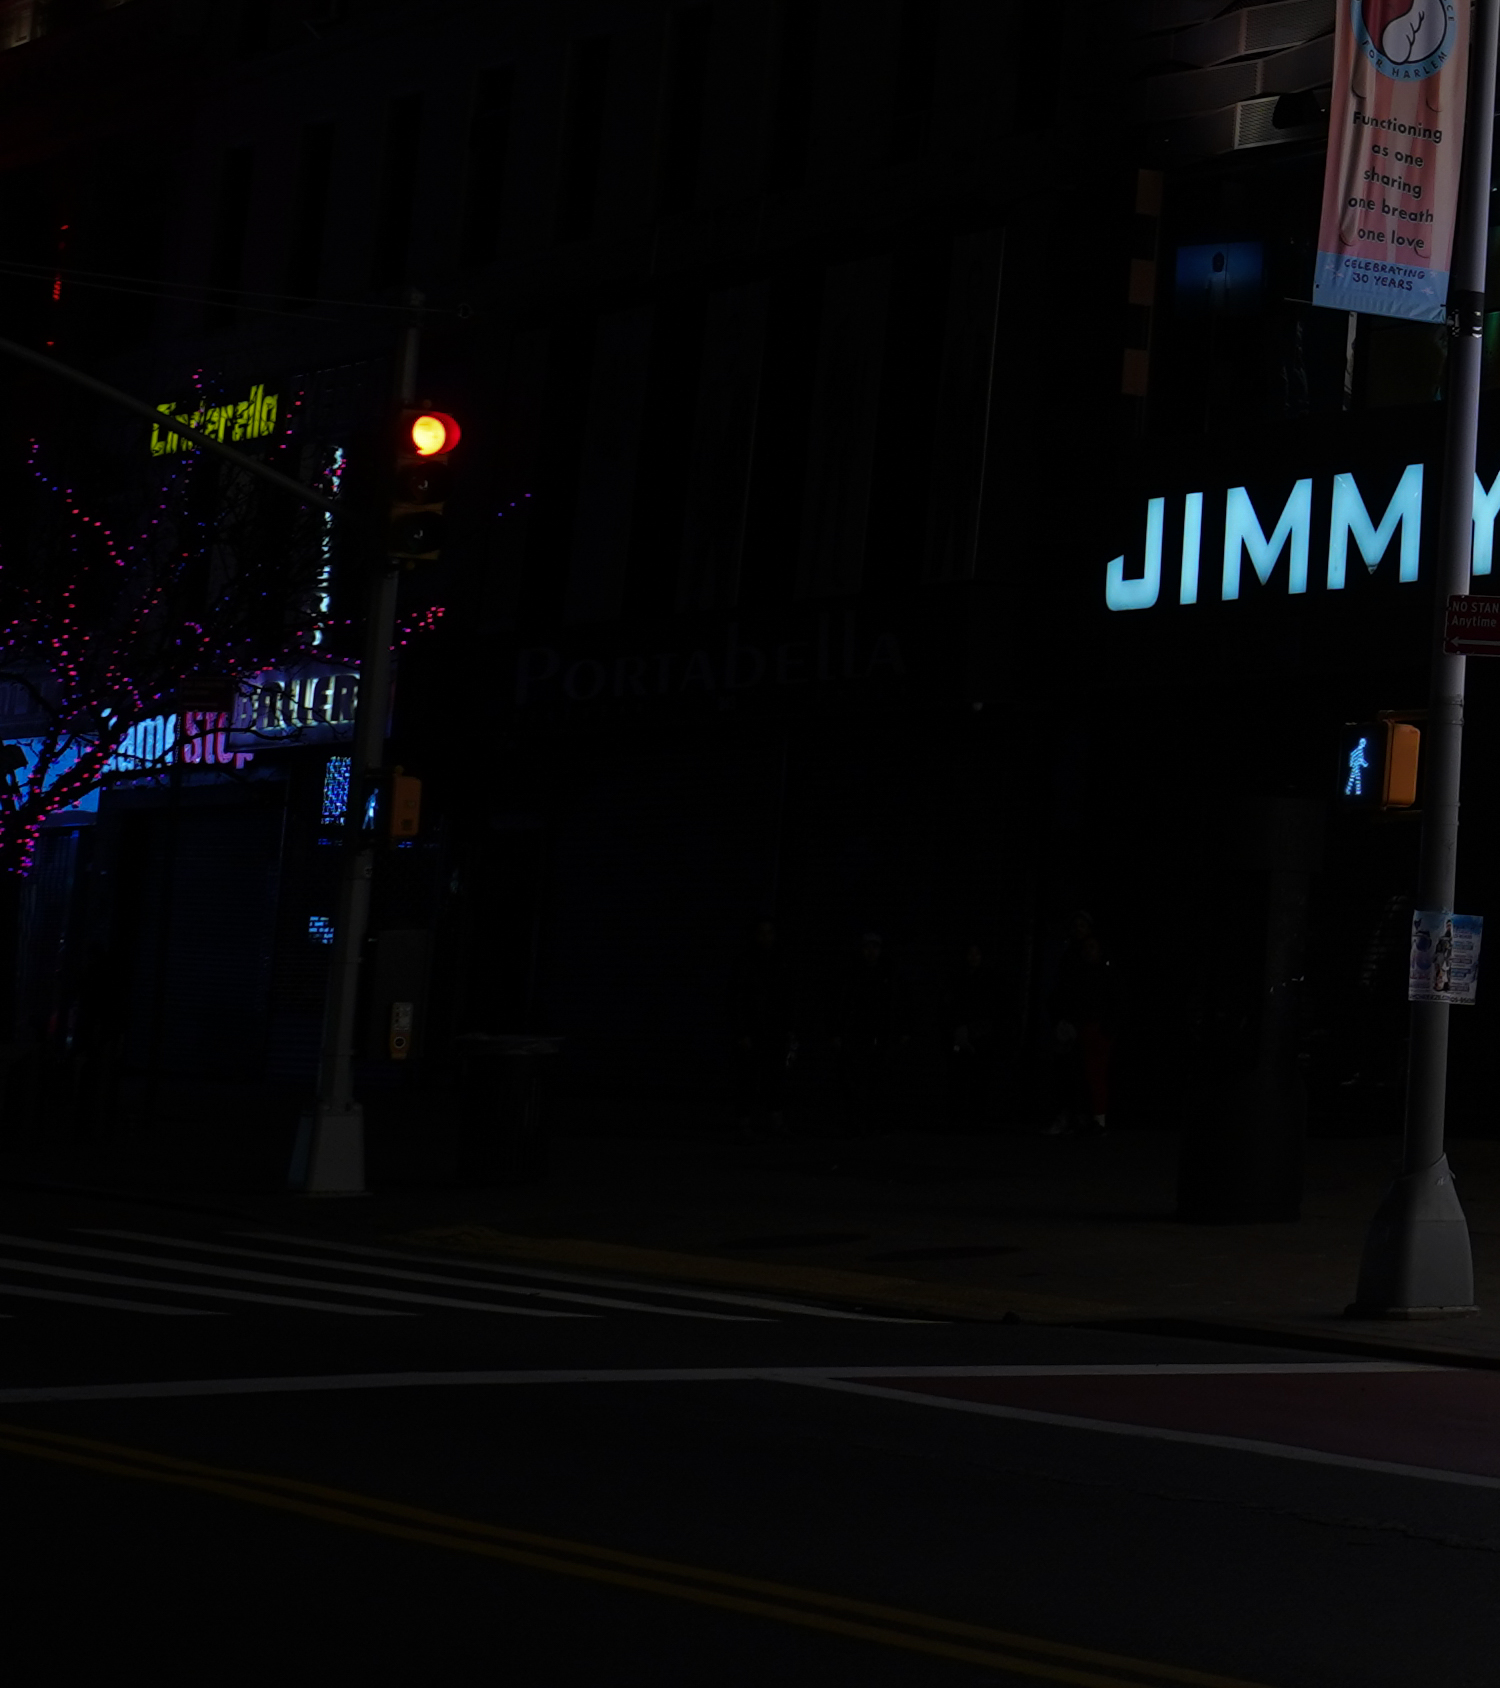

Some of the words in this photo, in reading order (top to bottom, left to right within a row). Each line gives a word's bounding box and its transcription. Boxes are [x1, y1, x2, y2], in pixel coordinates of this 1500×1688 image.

[1361, 39, 1383, 68] FOR
[1391, 51, 1448, 79] HARLEM
[1353, 111, 1443, 144] Functioning
[1371, 143, 1389, 158] as
[1394, 152, 1424, 168] one
[1363, 166, 1422, 199] sharing
[1348, 196, 1376, 211] one
[1381, 198, 1434, 223] breath
[1357, 228, 1385, 242] one
[1391, 230, 1425, 249] love
[1344, 259, 1426, 280] CELEBRATING
[1352, 272, 1369, 284] 30
[1373, 275, 1414, 292] YEARS
[1452, 601, 1468, 612] NO
[1451, 615, 1497, 628] Anytime
